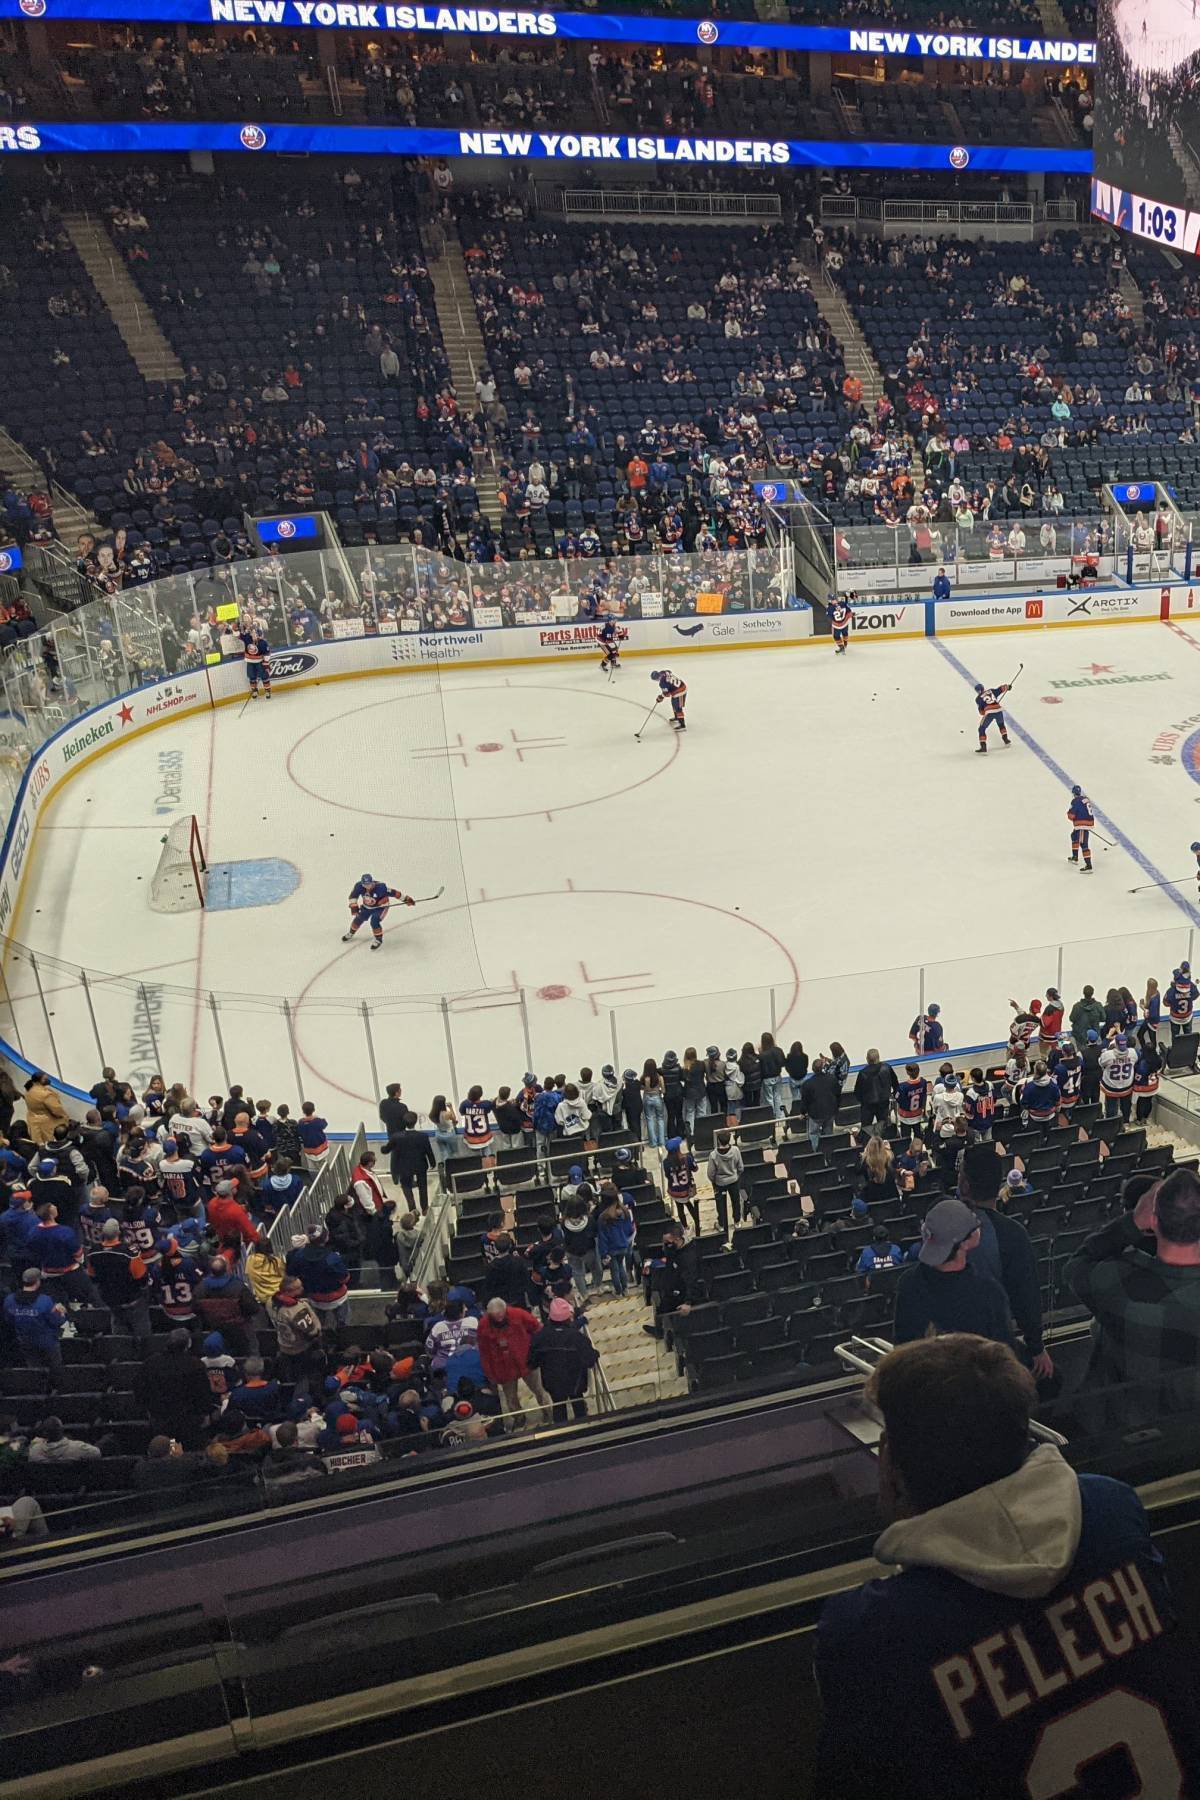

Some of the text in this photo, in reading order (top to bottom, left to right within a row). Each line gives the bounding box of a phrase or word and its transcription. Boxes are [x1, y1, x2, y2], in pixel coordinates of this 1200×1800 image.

[211, 1, 557, 35] NEW YORK ISLANDERS
[849, 31, 1096, 64] NEW YORK ISLANDE
[460, 132, 790, 163] NEW YORK ISLANDERS
[1138, 201, 1177, 243] 1:03
[1092, 597, 1139, 608] ARCTIX
[833, 607, 847, 623] 27
[950, 606, 1022, 618] Download the App
[539, 630, 572, 642] Parts
[574, 625, 628, 641] Authy
[712, 626, 735, 637] Gale
[743, 619, 782, 630] Sotheby's
[419, 633, 483, 648] Northwell
[420, 647, 461, 661] Health
[268, 656, 304, 678] Ford
[1048, 671, 1176, 689] Heineken
[146, 693, 197, 717] NHLSHOP.com
[62, 719, 115, 764] Heineken
[1152, 731, 1181, 752] UBS
[11, 810, 30, 881] GEICO
[1178, 999, 1189, 1014] 3
[1109, 1063, 1132, 1081] 29
[909, 1093, 920, 1111] 6
[465, 1114, 488, 1135] 13
[215, 1158, 229, 1167] LEE
[670, 1169, 689, 1187] 13
[161, 1281, 193, 1305] 13
[297, 1312, 313, 1329] 73
[330, 1453, 367, 1469] HISCHIER
[932, 1561, 1164, 1738] PELECH
